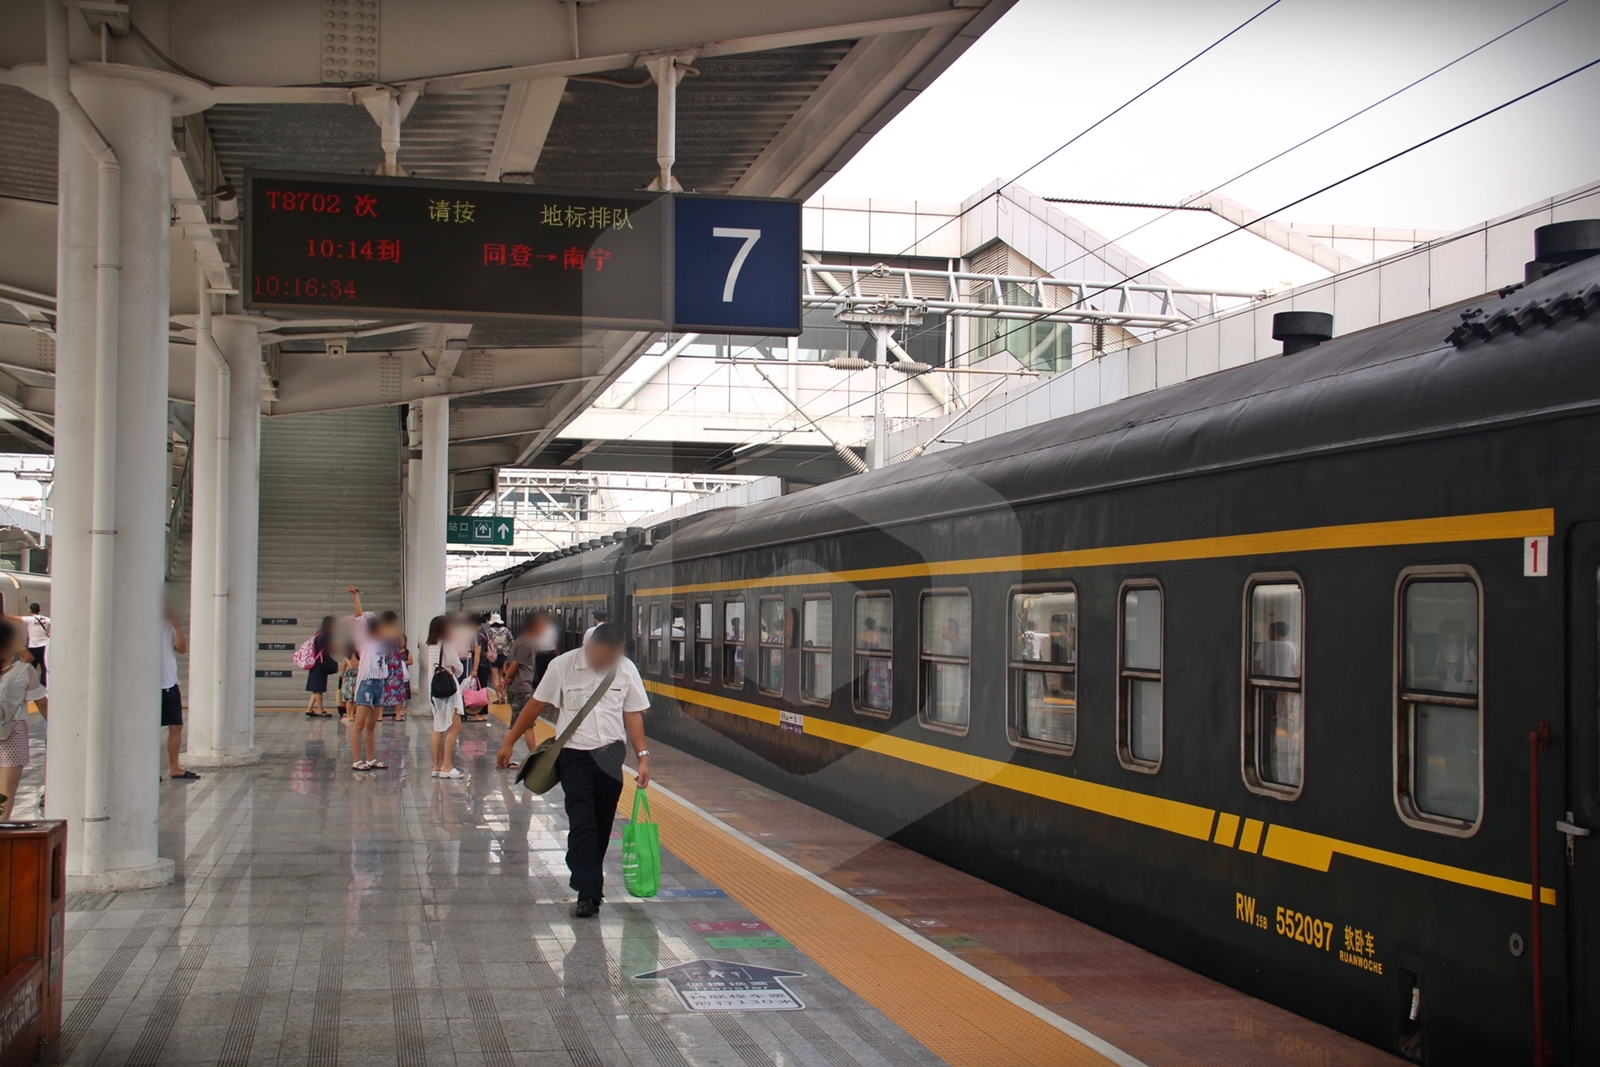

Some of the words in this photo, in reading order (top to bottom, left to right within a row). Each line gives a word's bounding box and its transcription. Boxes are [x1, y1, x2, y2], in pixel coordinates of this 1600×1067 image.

[266, 190, 341, 213] T8702
[354, 194, 378, 217] 次
[428, 198, 476, 223] 请按
[540, 203, 634, 230] 地标排队
[306, 238, 401, 263] 10:14到
[711, 227, 762, 303] 7
[254, 276, 357, 299] 10:16:34
[1530, 539, 1538, 573] 1
[1275, 905, 1334, 951] 552097
[1344, 924, 1376, 958] 软卧车
[1339, 950, 1383, 975] RUANWOCHE
